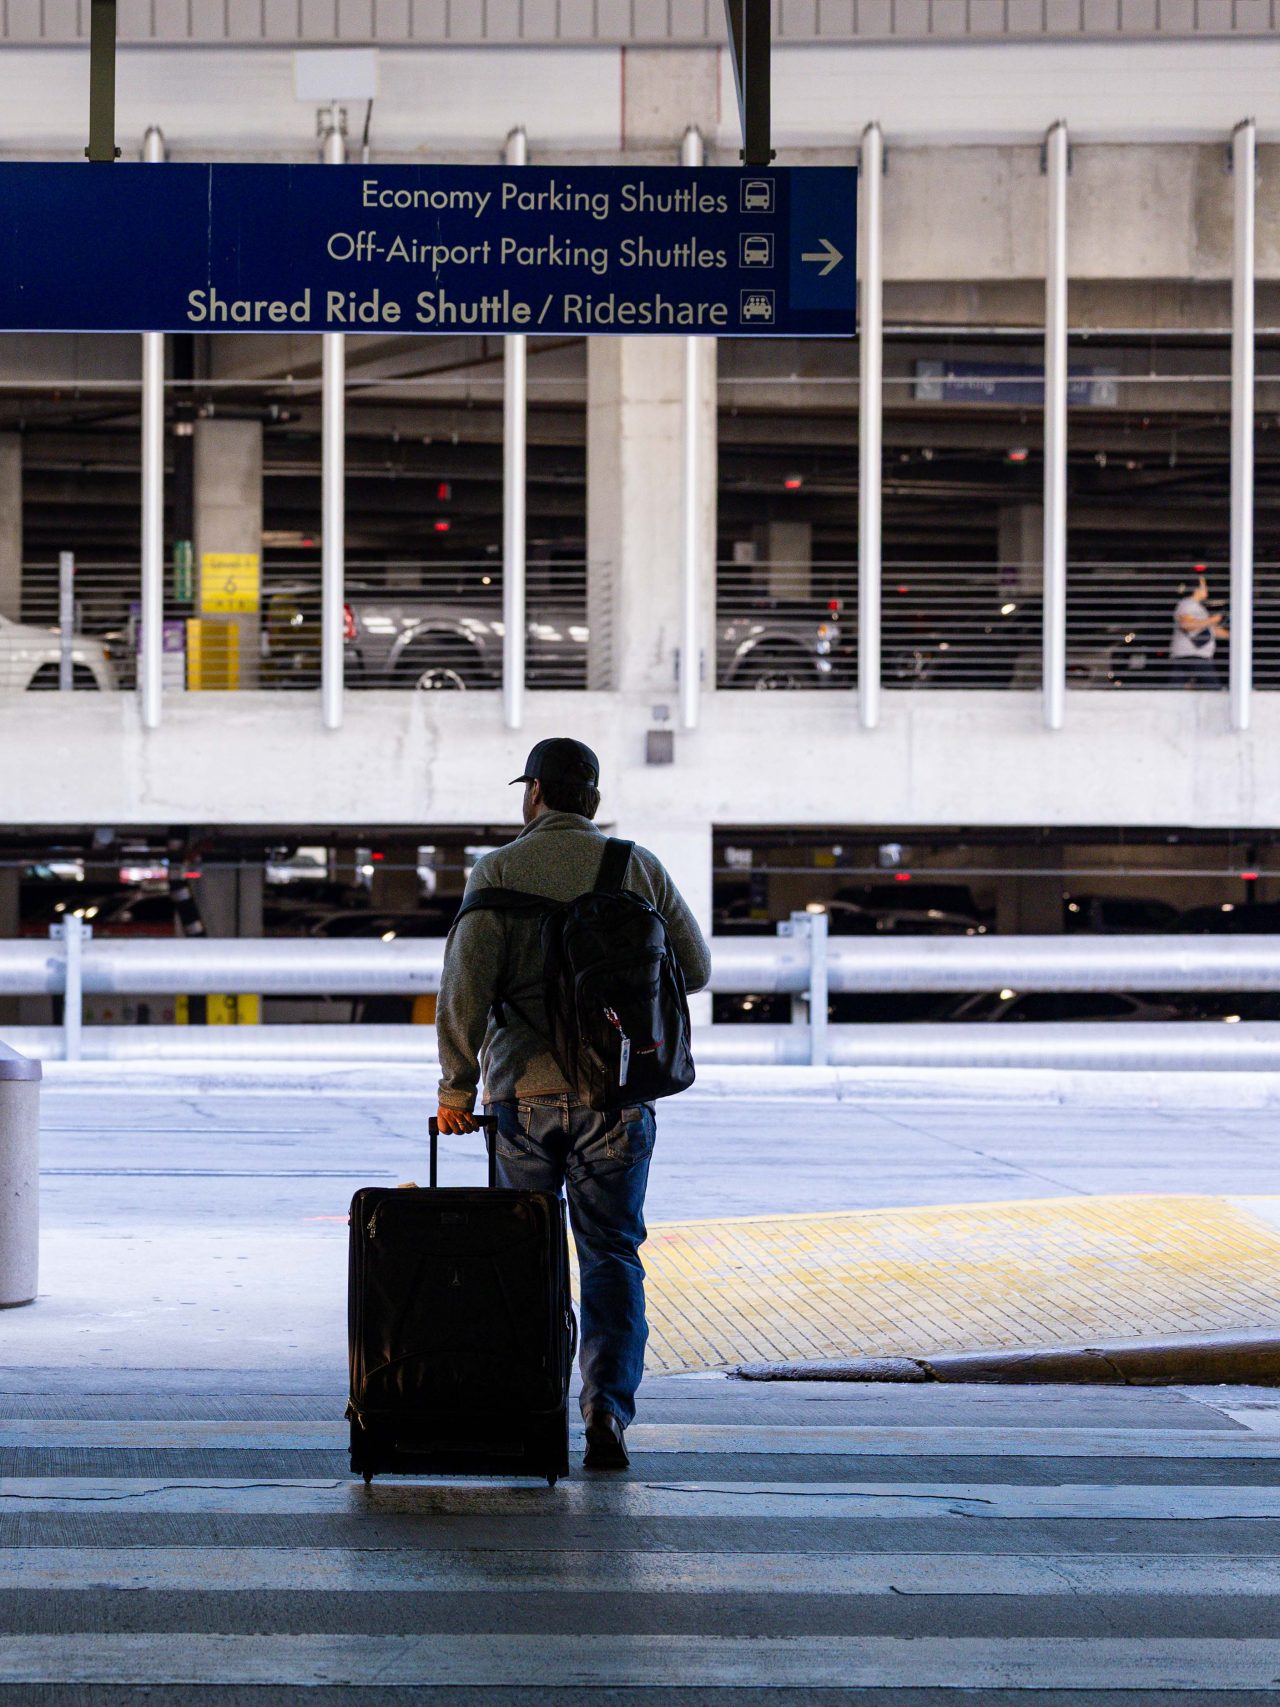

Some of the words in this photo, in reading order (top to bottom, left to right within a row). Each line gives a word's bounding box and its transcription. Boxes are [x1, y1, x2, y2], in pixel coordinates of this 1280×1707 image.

[362, 180, 491, 218] Economy
[501, 180, 609, 219] Parking
[620, 181, 728, 213] Shuttles
[327, 231, 491, 272] Off-Airport
[501, 234, 608, 275] Parking
[619, 236, 727, 268] Shuttles
[186, 289, 311, 324] Shared
[325, 289, 402, 324] Ride
[415, 290, 531, 325] Shuttle
[563, 293, 728, 326] Rideshare
